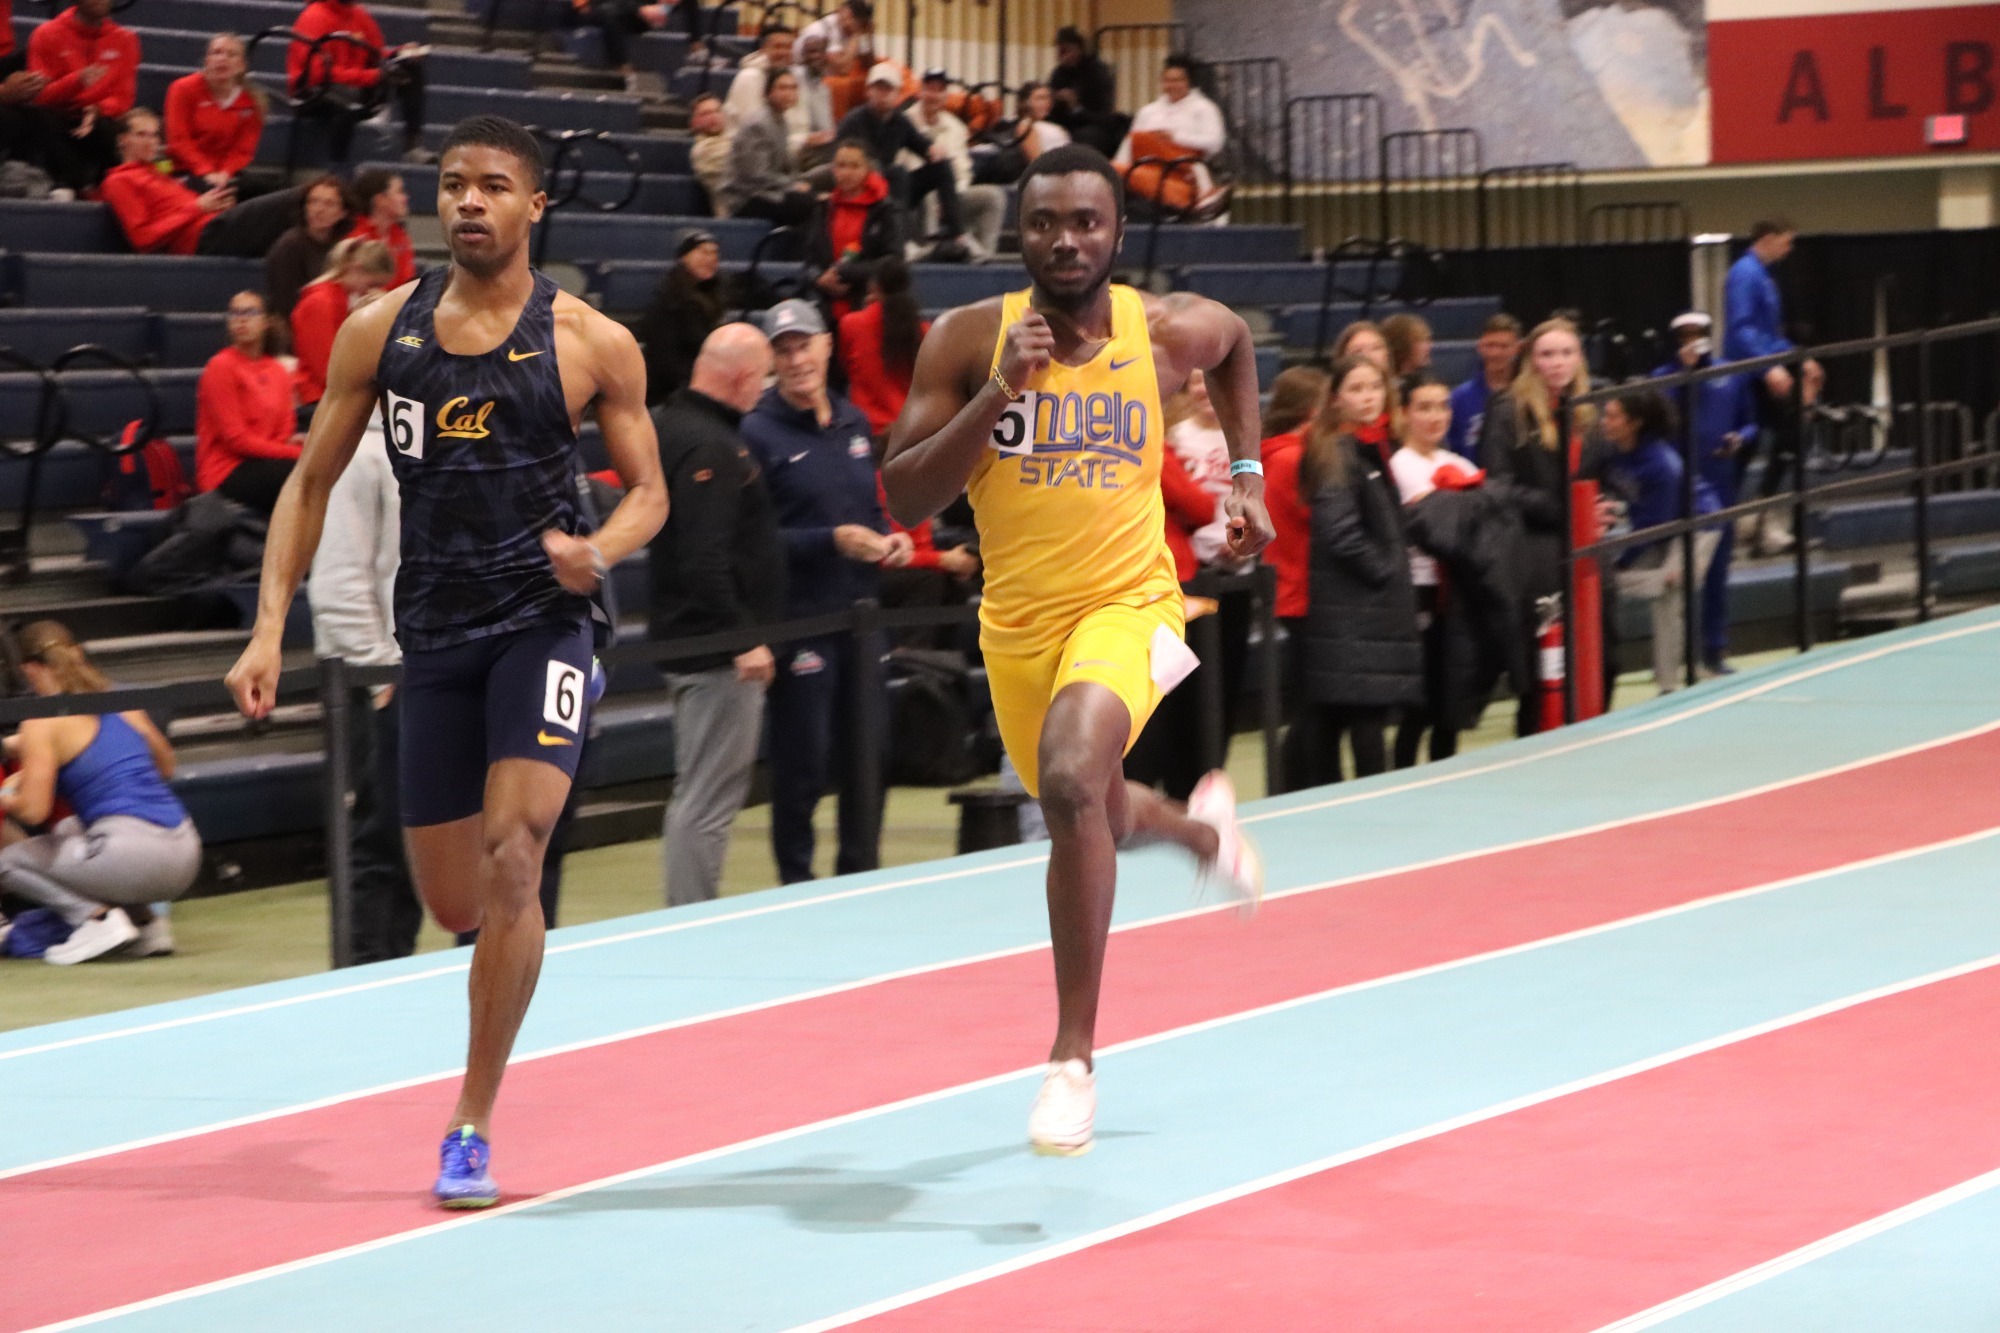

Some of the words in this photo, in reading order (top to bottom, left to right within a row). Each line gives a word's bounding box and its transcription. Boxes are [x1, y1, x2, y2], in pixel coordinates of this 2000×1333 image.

[393, 400, 413, 451] 6
[436, 396, 495, 439] Cal
[993, 394, 1025, 447] 5
[1034, 391, 1147, 451] ngelo
[556, 670, 575, 721] 6
